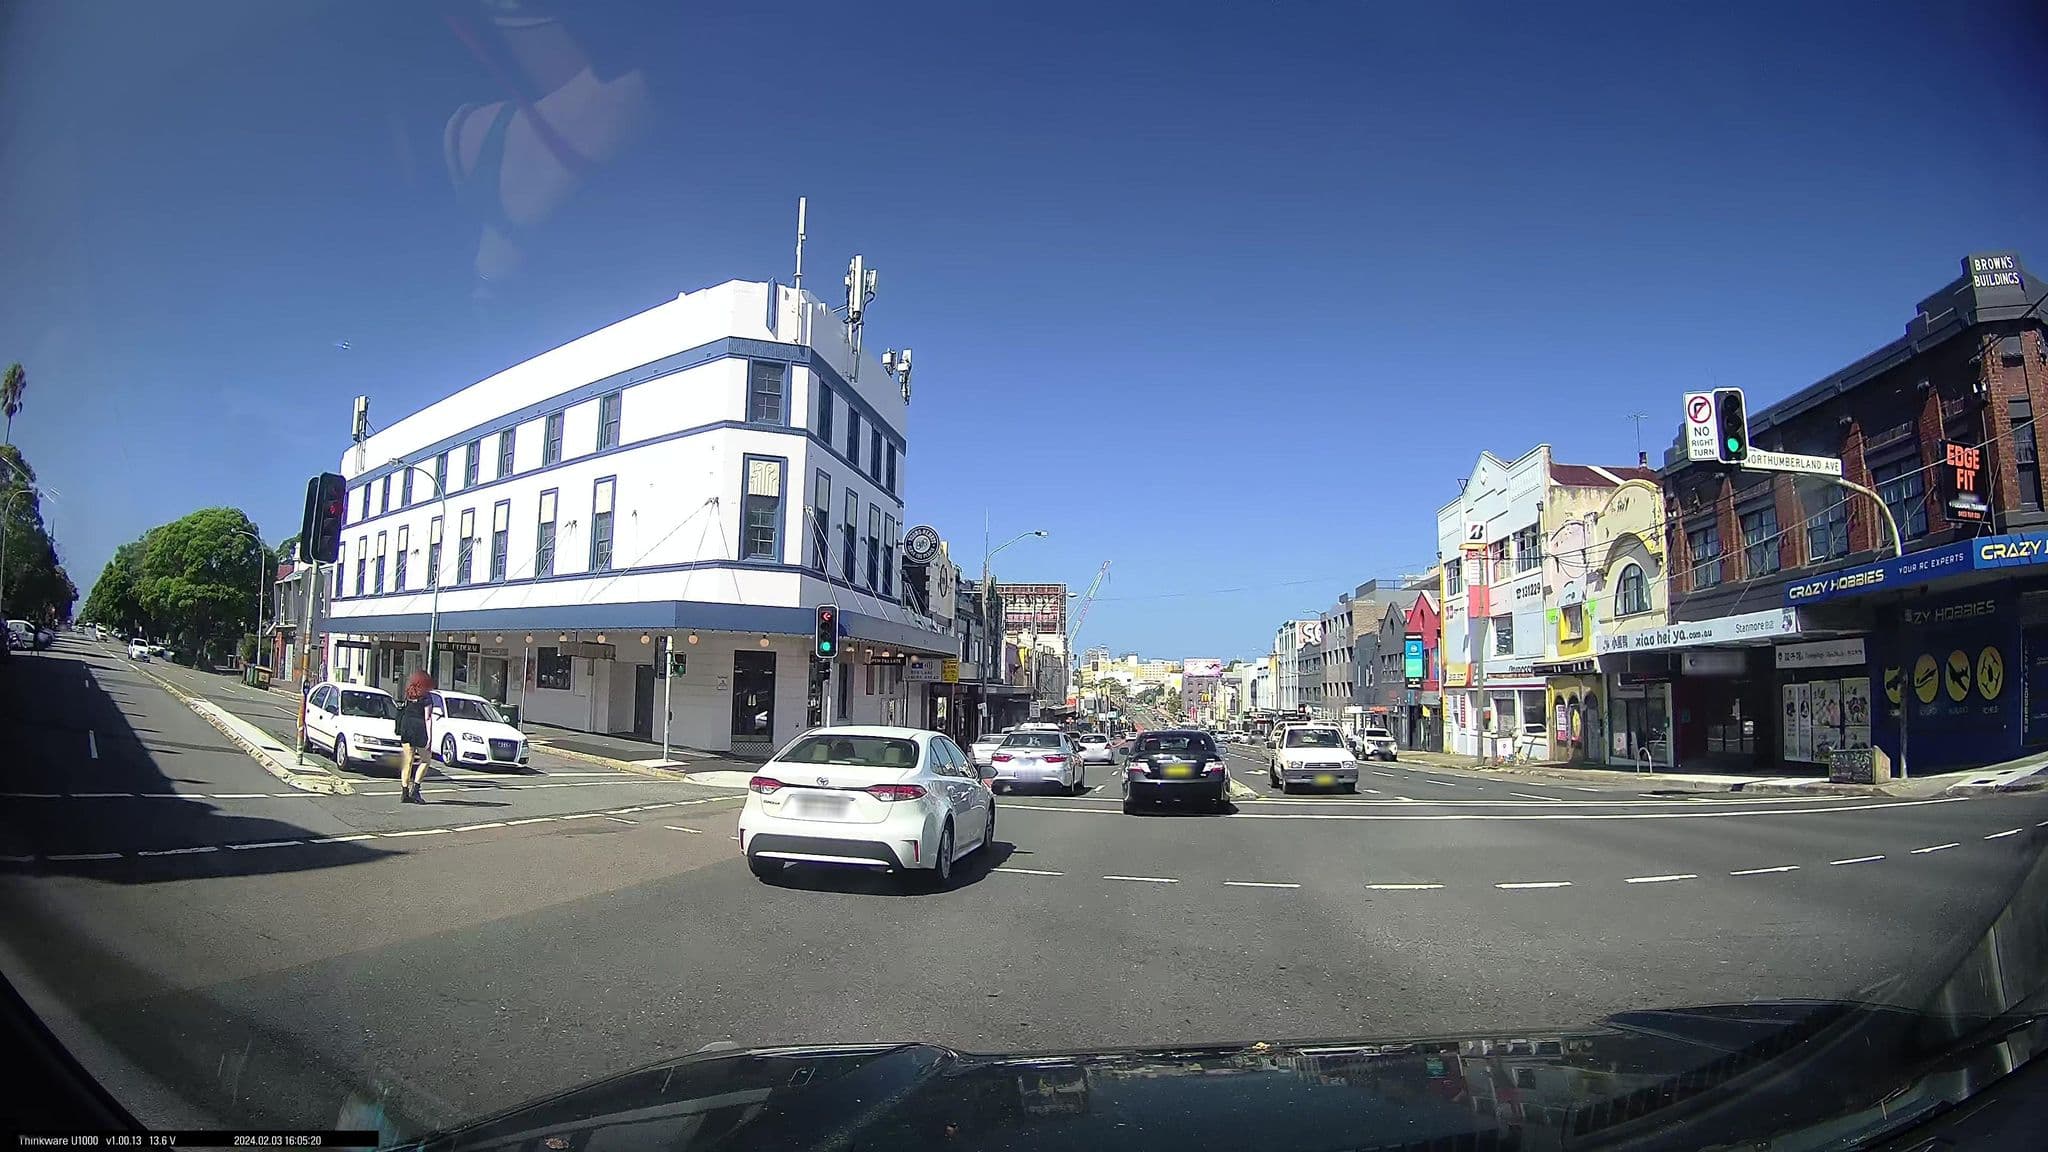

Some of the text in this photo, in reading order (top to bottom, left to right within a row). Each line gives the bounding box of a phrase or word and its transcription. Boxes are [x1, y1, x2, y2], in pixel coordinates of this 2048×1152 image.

[1974, 255, 2014, 271] BROWN'S
[1973, 272, 2020, 287] BUILDINGS
[1694, 426, 1710, 436] NO
[1691, 439, 1713, 447] RIGHT
[1694, 448, 1714, 457] TURN
[1946, 443, 1980, 470] EDGE
[1824, 461, 1840, 472] AVE
[1956, 468, 1976, 491] FIT
[1980, 540, 2042, 560] CRAZY
[1898, 552, 1964, 574] YOUR RC EXPERTS
[1789, 569, 1884, 599] CRAZY HOBBIES
[1935, 600, 1996, 621] HOBBIES
[1735, 621, 1765, 634] Stanmore
[1635, 629, 1713, 647] xiao hei ya.com.au
